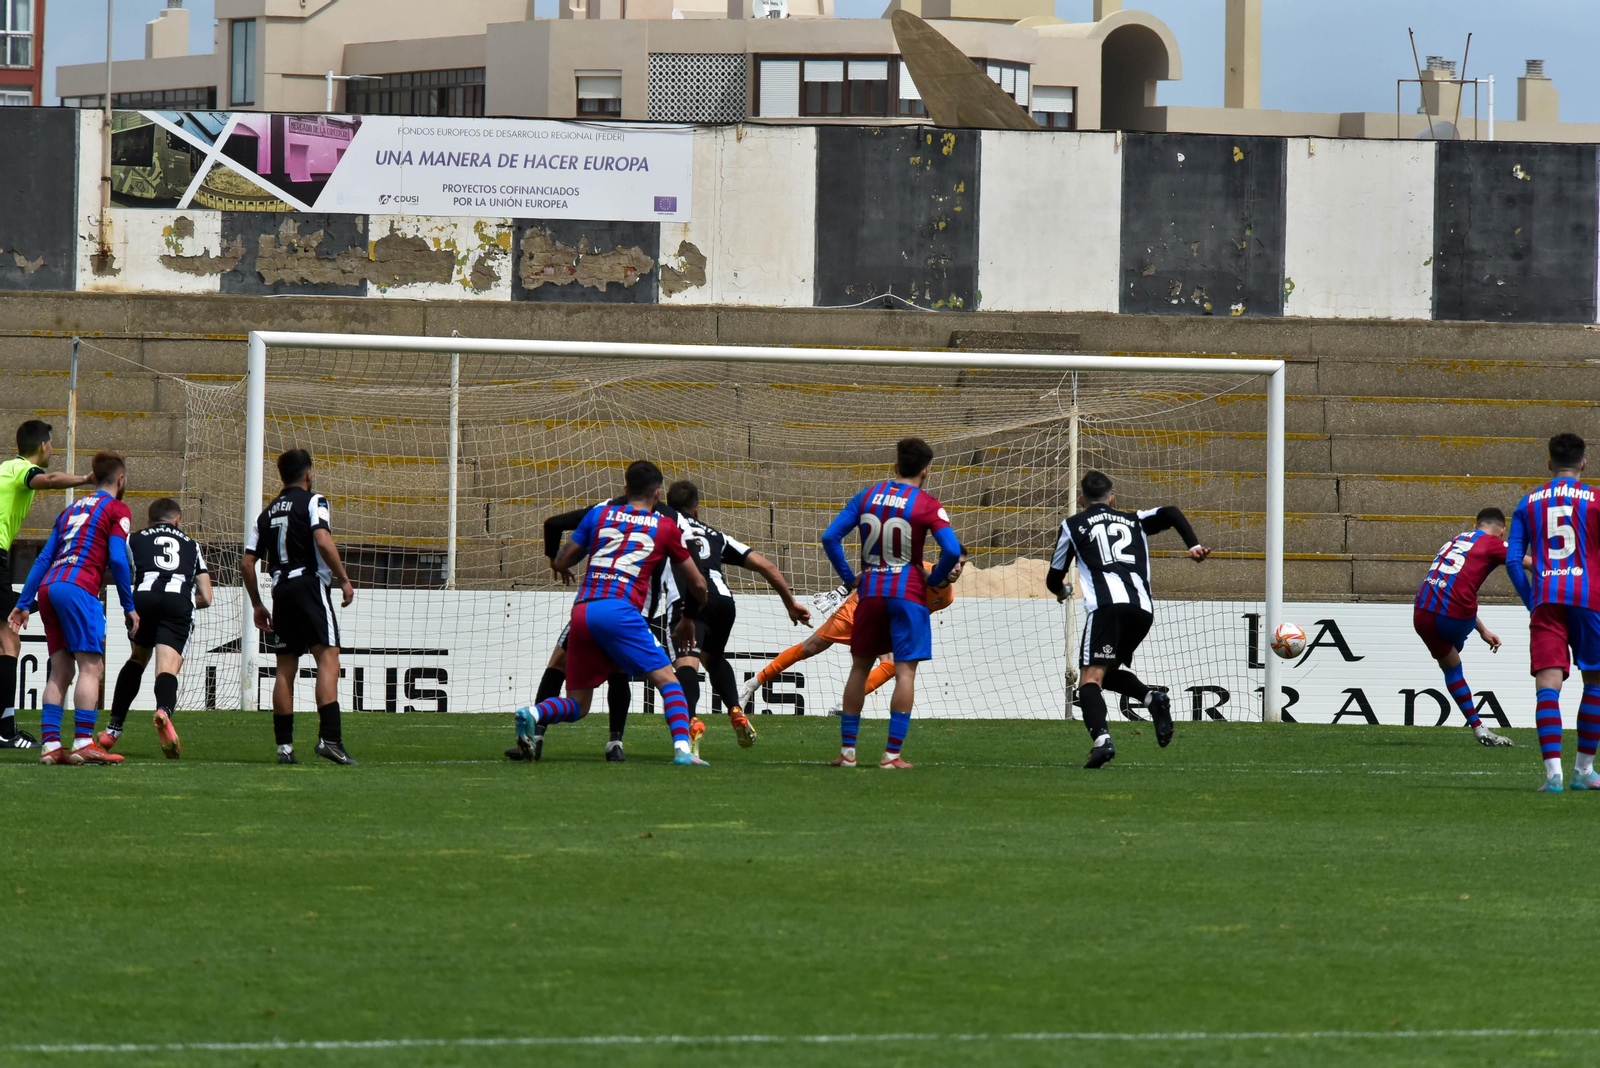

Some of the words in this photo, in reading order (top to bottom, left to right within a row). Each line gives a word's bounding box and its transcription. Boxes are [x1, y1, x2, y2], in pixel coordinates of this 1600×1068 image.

[397, 127, 435, 136] FONDOS
[437, 128, 481, 137] EUROPEOS
[483, 129, 494, 138] DE
[496, 130, 549, 139] DESARROLLO
[551, 131, 593, 140] REGIONAL
[595, 132, 625, 142] (FEDER)
[375, 150, 413, 166] UNA
[418, 151, 492, 168] MANERA
[497, 153, 519, 169] DE
[523, 154, 579, 170] HACER
[583, 155, 649, 172] EUROPA
[442, 184, 497, 194] PROYECTOS
[499, 185, 580, 197] COFINANCIADOS
[453, 197, 472, 206] POR
[475, 198, 487, 207] LA
[489, 196, 523, 208] UNIÓN
[525, 198, 569, 209] EUROPEA
[871, 493, 884, 505] EZ
[883, 494, 908, 510] ABDE
[1528, 487, 1552, 504] MIKA
[1553, 484, 1596, 502] MÁRMOL
[63, 513, 90, 553] 7
[615, 511, 659, 528] ESCOBAR
[1087, 512, 1136, 528] MONTEVERDE
[1547, 505, 1576, 560] 5
[140, 527, 191, 542] SAMANES
[269, 515, 289, 564] 7
[860, 513, 912, 567] 20
[1088, 522, 1136, 566] 12
[153, 536, 180, 571] 3
[589, 527, 655, 577] 22
[1429, 540, 1475, 574] 23
[1541, 567, 1571, 577] unicef
[1242, 613, 1365, 669] LA
[1072, 685, 1513, 728] ERRADA
